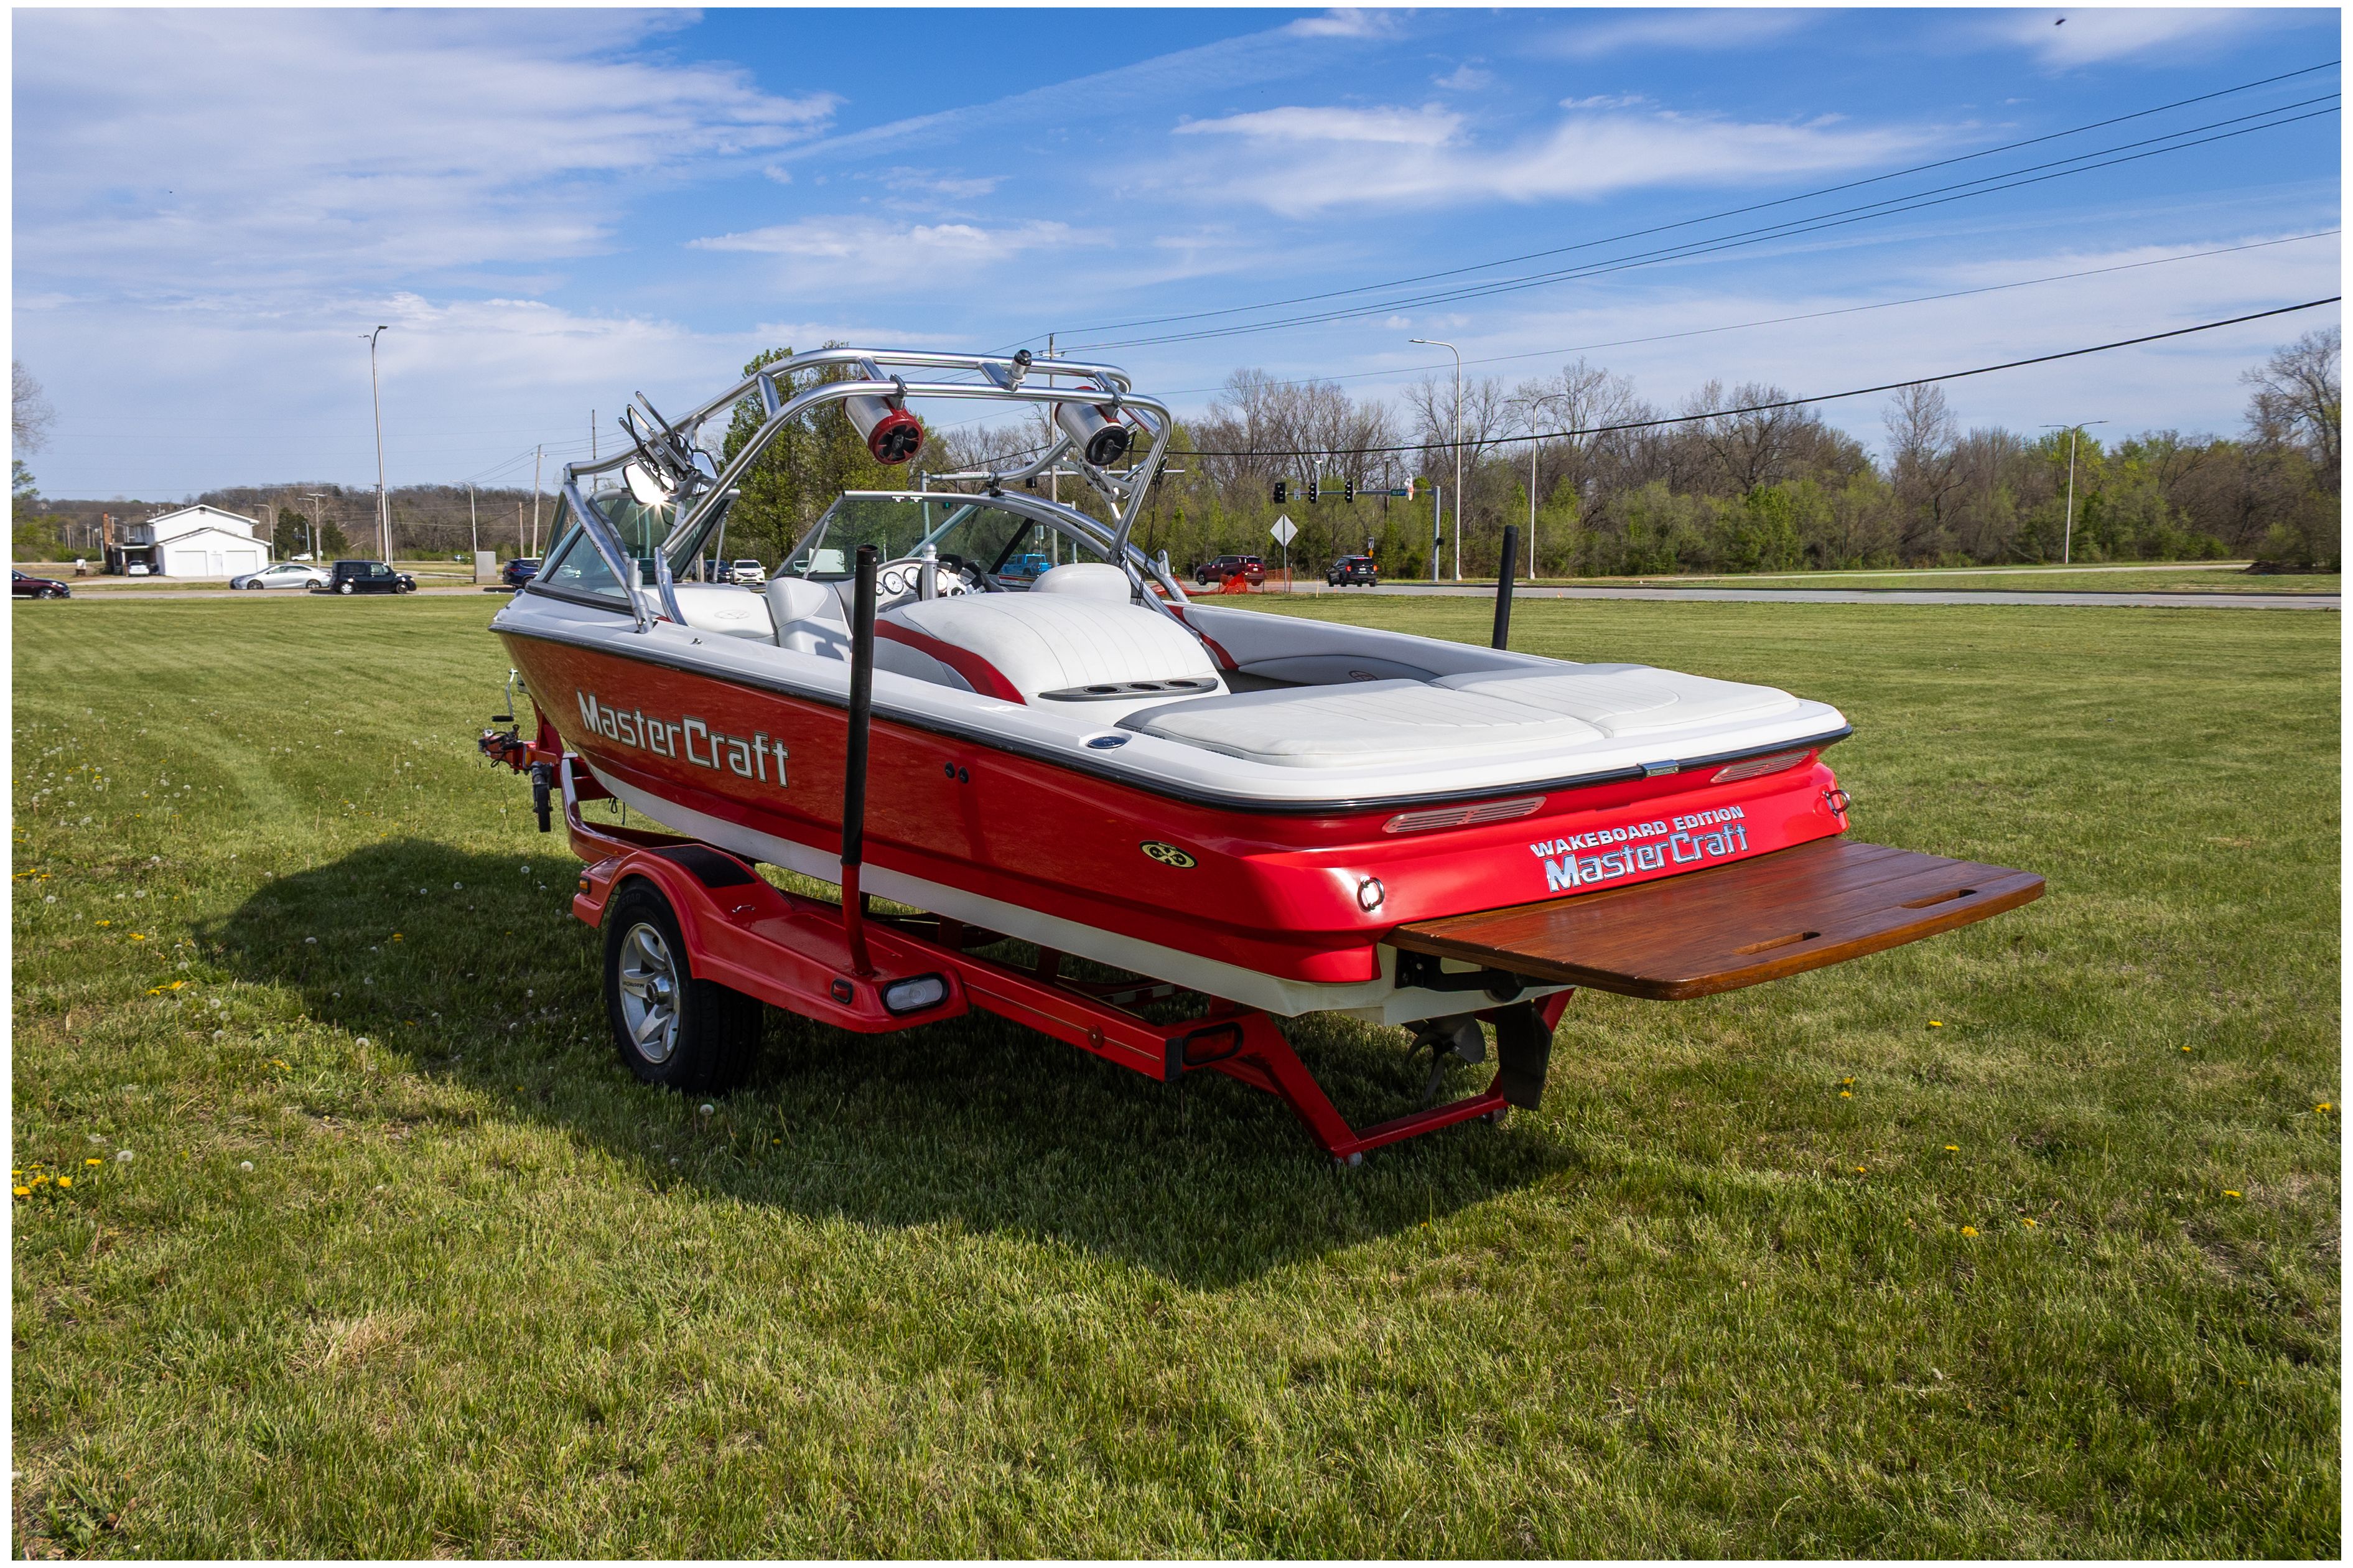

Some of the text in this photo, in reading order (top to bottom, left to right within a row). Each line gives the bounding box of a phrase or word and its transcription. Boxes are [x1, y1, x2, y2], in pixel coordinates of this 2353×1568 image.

[576, 688, 790, 788] MasterCraft
[1530, 806, 1746, 857] WAKEBOARD EDITION
[1544, 823, 1749, 892] MasterCraft
